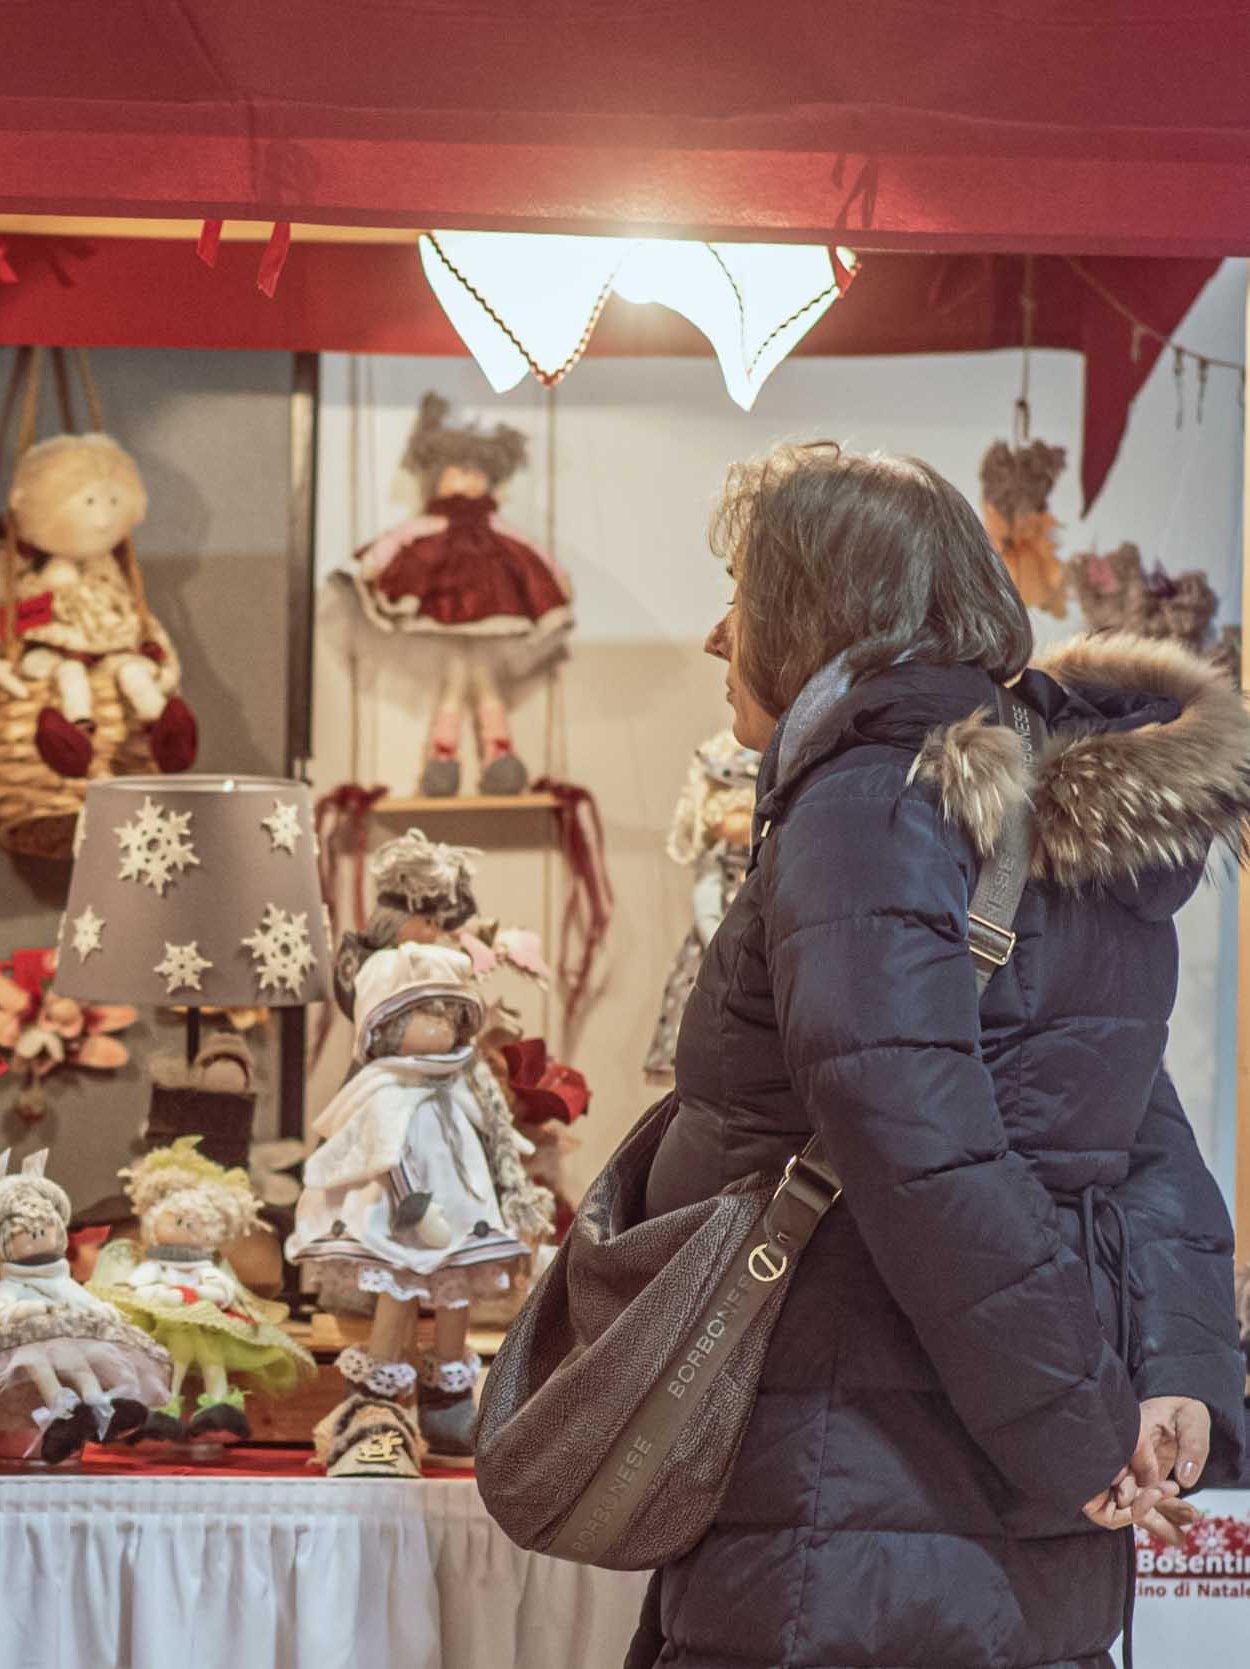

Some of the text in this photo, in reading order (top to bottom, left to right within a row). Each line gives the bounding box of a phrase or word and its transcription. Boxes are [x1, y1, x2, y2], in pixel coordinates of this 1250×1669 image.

[667, 1273, 750, 1399] BORBONES
[1137, 1549, 1250, 1573] Bosenti
[1137, 1582, 1166, 1597] ino
[1174, 1581, 1190, 1597] di
